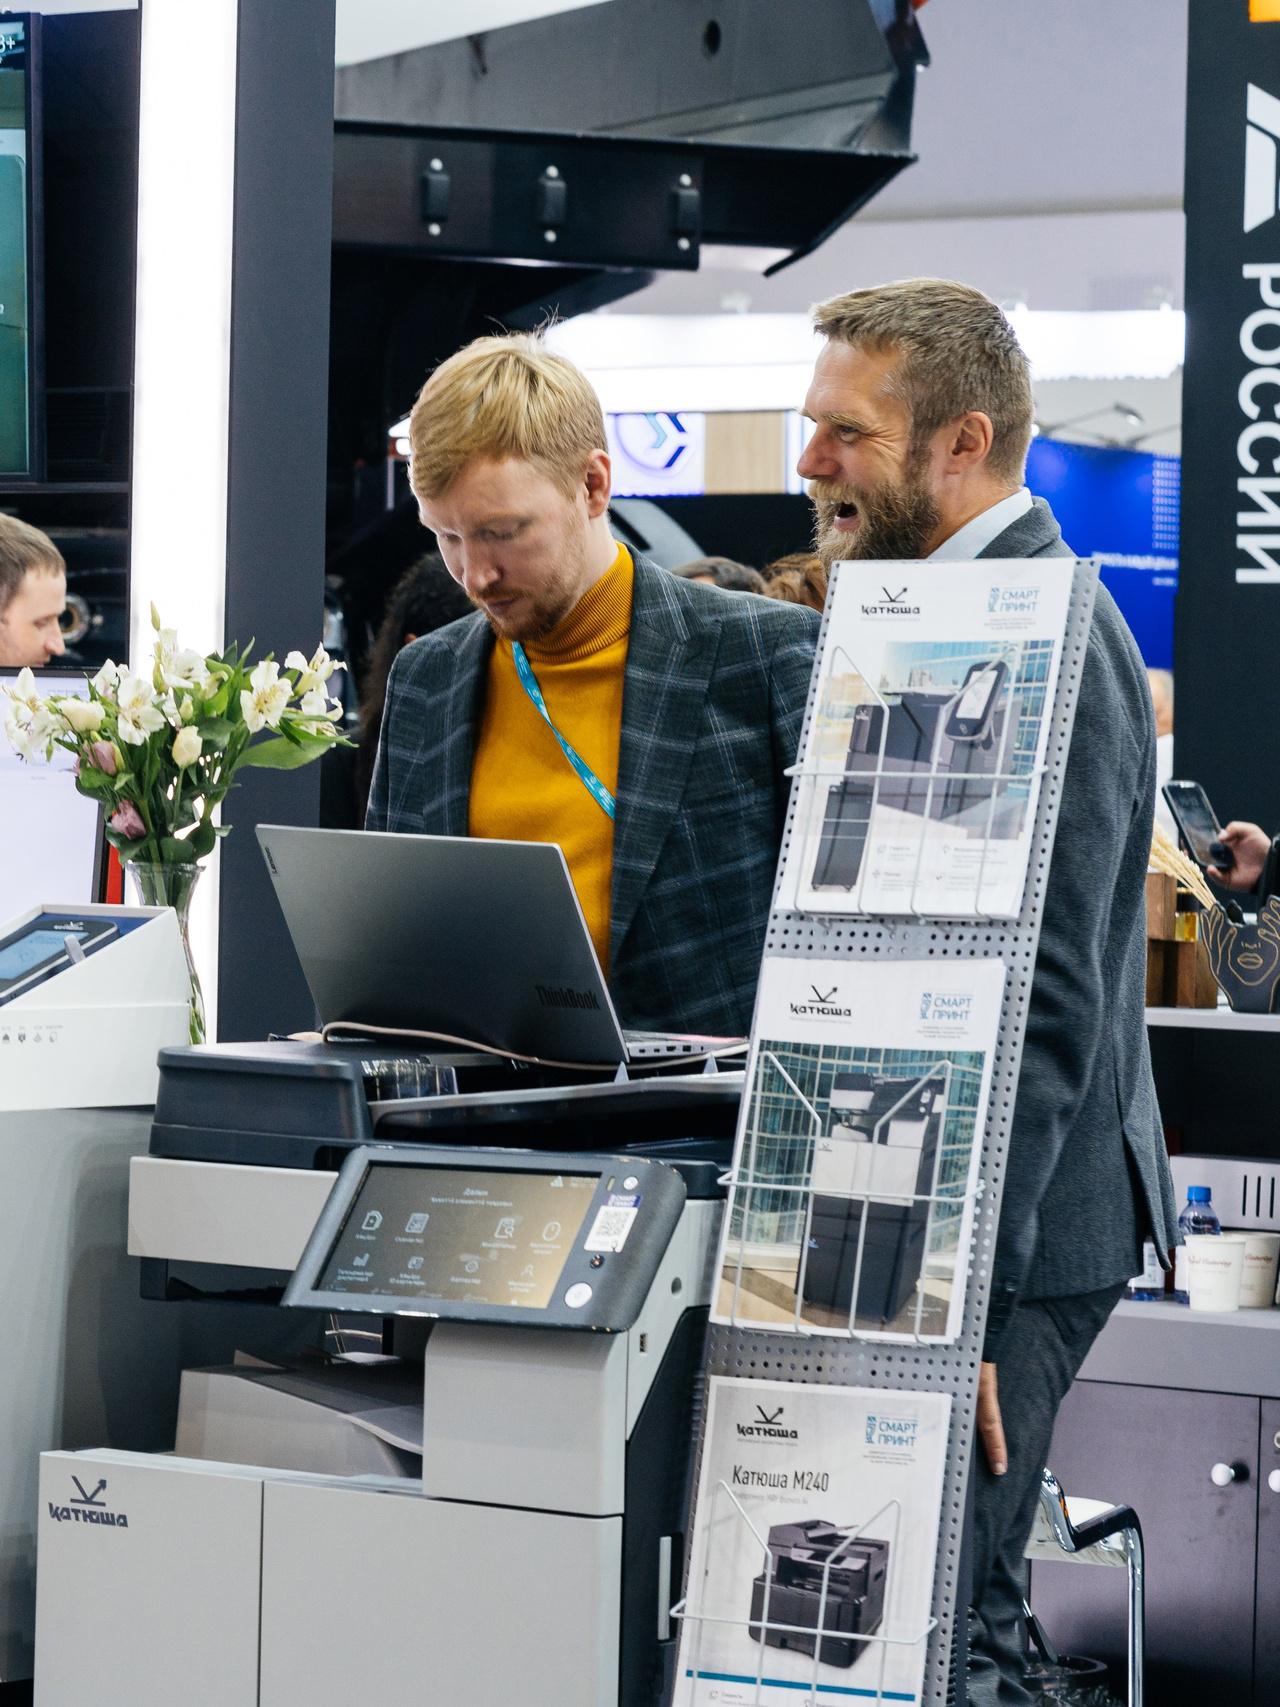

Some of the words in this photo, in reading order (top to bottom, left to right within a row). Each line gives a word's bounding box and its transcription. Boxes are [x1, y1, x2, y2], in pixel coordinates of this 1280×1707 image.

[1235, 262, 1280, 584] РОССИИ
[1002, 590, 1041, 601] СМАРТ
[1000, 601, 1038, 612] ПРИНТ
[534, 985, 600, 1010] ThinkBook
[934, 997, 973, 1009] СМАРТ
[932, 1009, 971, 1021] ПРИНТ
[879, 1421, 918, 1434] СМАРТ
[878, 1434, 917, 1447] ПРИНТ
[732, 1464, 788, 1489] Катюша
